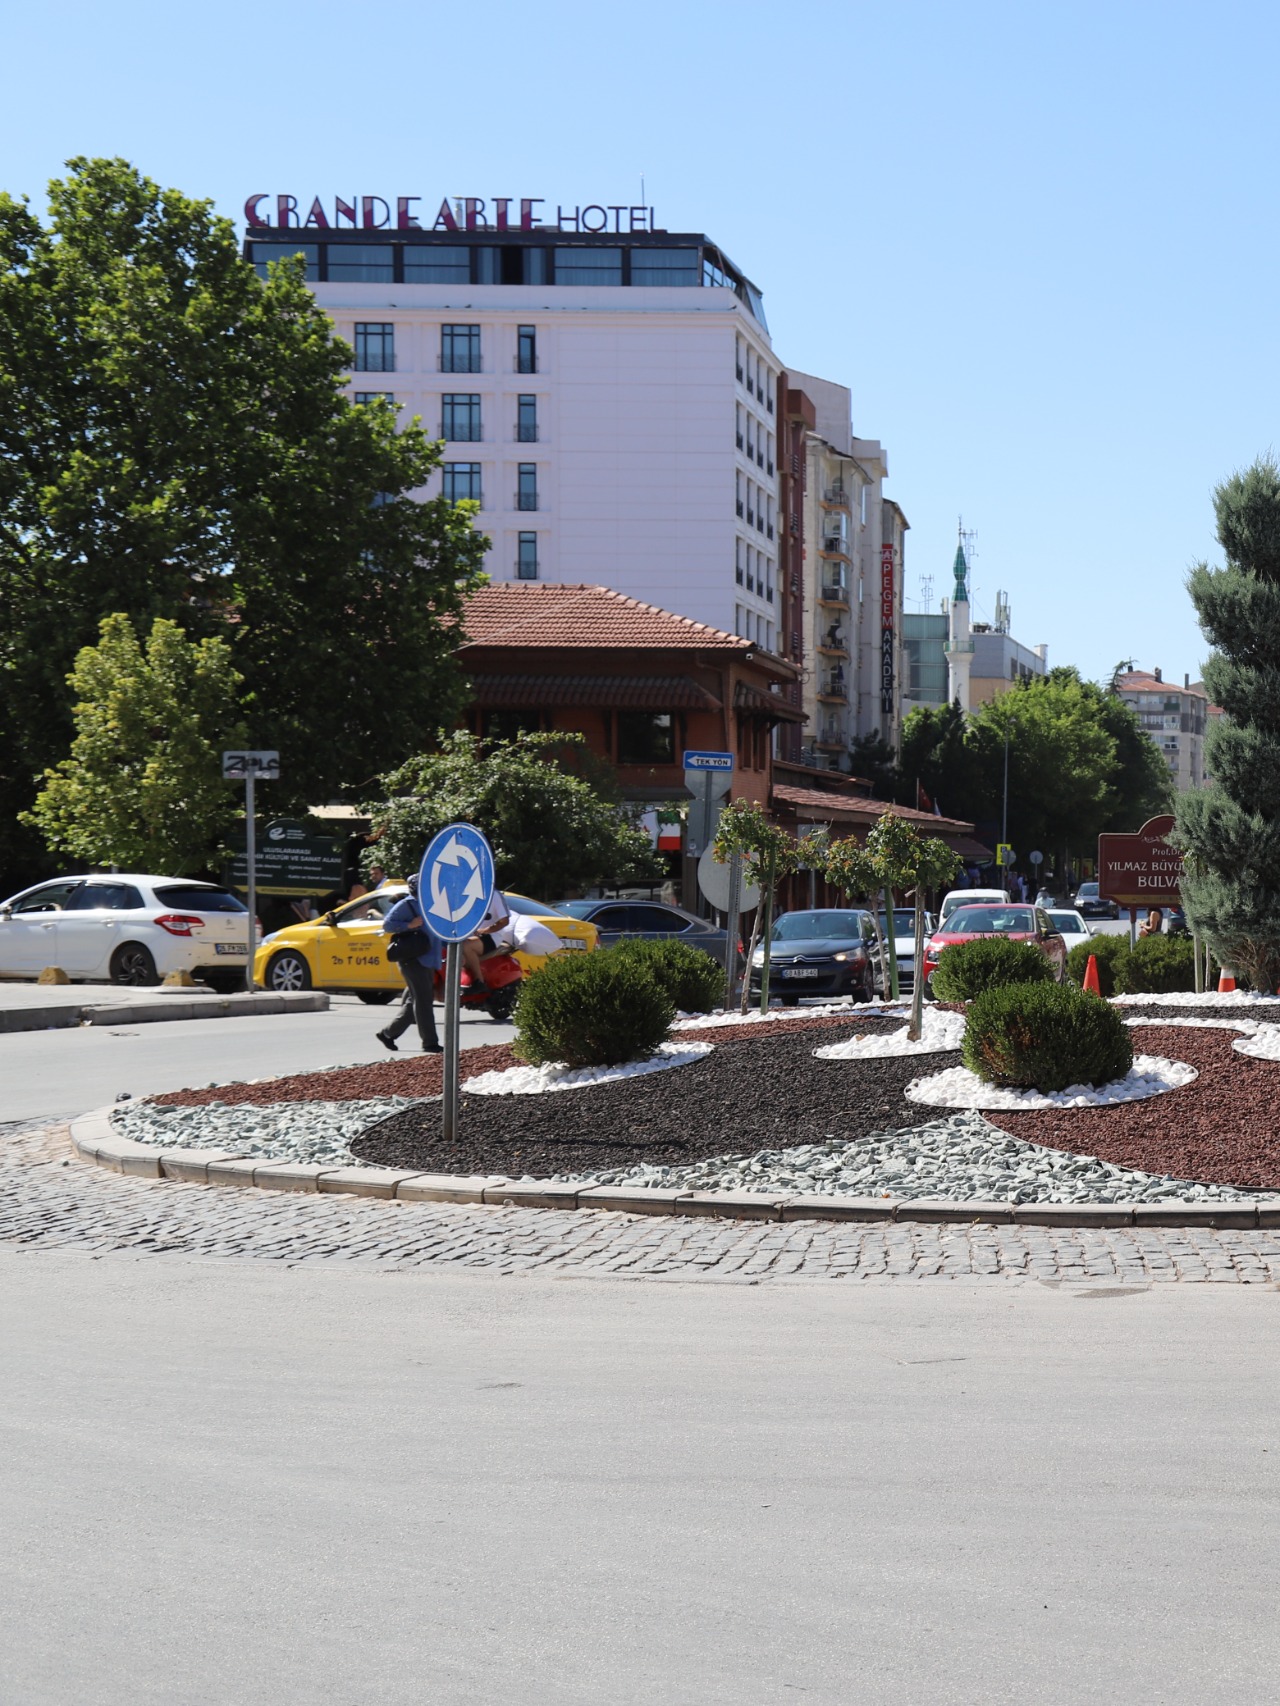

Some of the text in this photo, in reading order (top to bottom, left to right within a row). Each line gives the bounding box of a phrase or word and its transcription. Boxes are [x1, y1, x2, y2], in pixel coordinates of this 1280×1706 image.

[244, 193, 667, 233] GRANDE ARTE HOTEL
[882, 563, 893, 626] PEGEM
[713, 758, 728, 766] YÖN
[1107, 862, 1148, 871] YILMAZ
[347, 956, 353, 965] T
[356, 956, 380, 966] 0146
